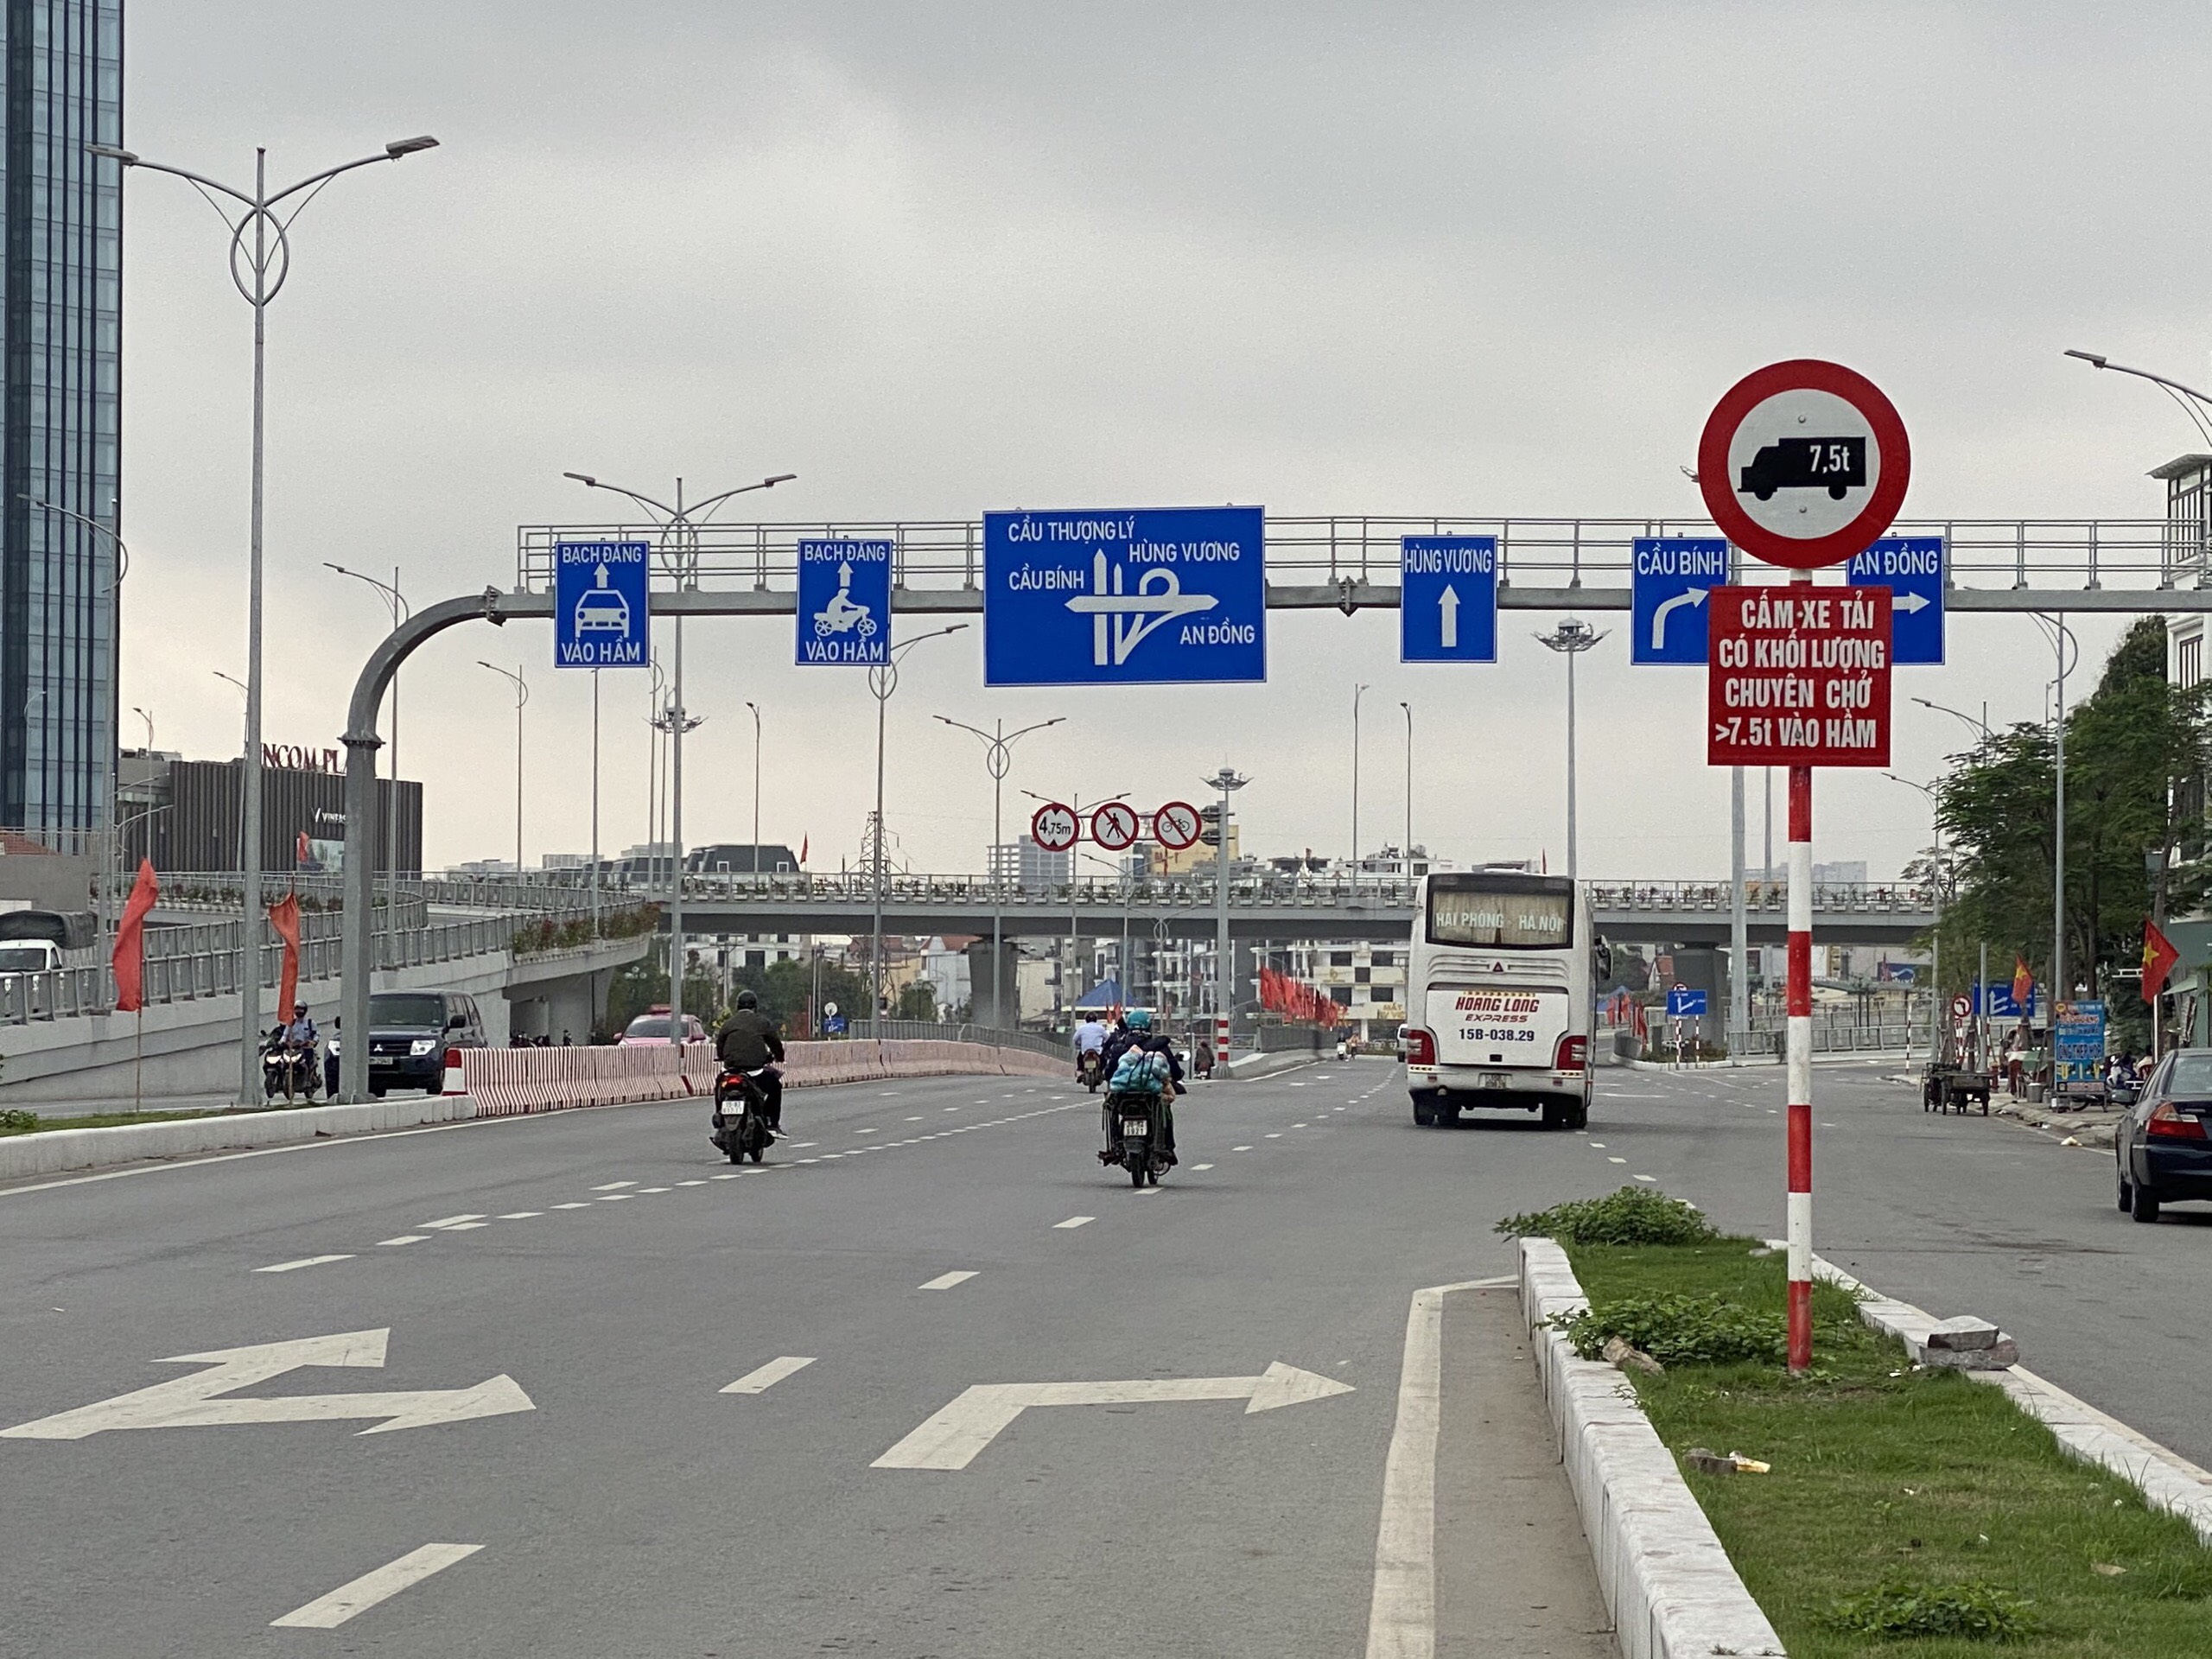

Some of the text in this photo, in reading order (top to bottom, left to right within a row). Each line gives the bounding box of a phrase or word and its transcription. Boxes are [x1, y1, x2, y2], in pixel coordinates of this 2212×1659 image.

[1809, 444, 1850, 474] 7,5t
[1008, 514, 1135, 543] CẦU THƯỢNG LÝ
[563, 546, 600, 565] BẠCH
[804, 543, 843, 564] BẠCH
[1129, 538, 1240, 563] HÙNG VƯƠNG
[1404, 543, 1492, 573] HÙNG VƯƠNG
[1637, 542, 1724, 575] CẦU BÍNH
[1852, 542, 1938, 575] AN ĐỒNG
[1008, 563, 1084, 590] CẦU BÍNH
[1741, 588, 1875, 629] CẤM XE TẢI
[1180, 617, 1255, 645] AN ĐỒNG
[562, 635, 640, 663] VÀO HẦM
[805, 636, 839, 661] VÀO
[1719, 628, 1885, 674] CÓ KHỐI LƯỢNG
[1725, 669, 1872, 709] CHUYÊN CHỞ
[1715, 708, 1877, 748] >7.5t VÀO HẦM
[262, 742, 346, 775] NCOM PL
[1039, 816, 1071, 836] 4,75m
[1455, 996, 1540, 1013] HOANG LONG
[1465, 1014, 1529, 1023] EXPRESS
[1459, 1028, 1535, 1042] 15B-038.29
